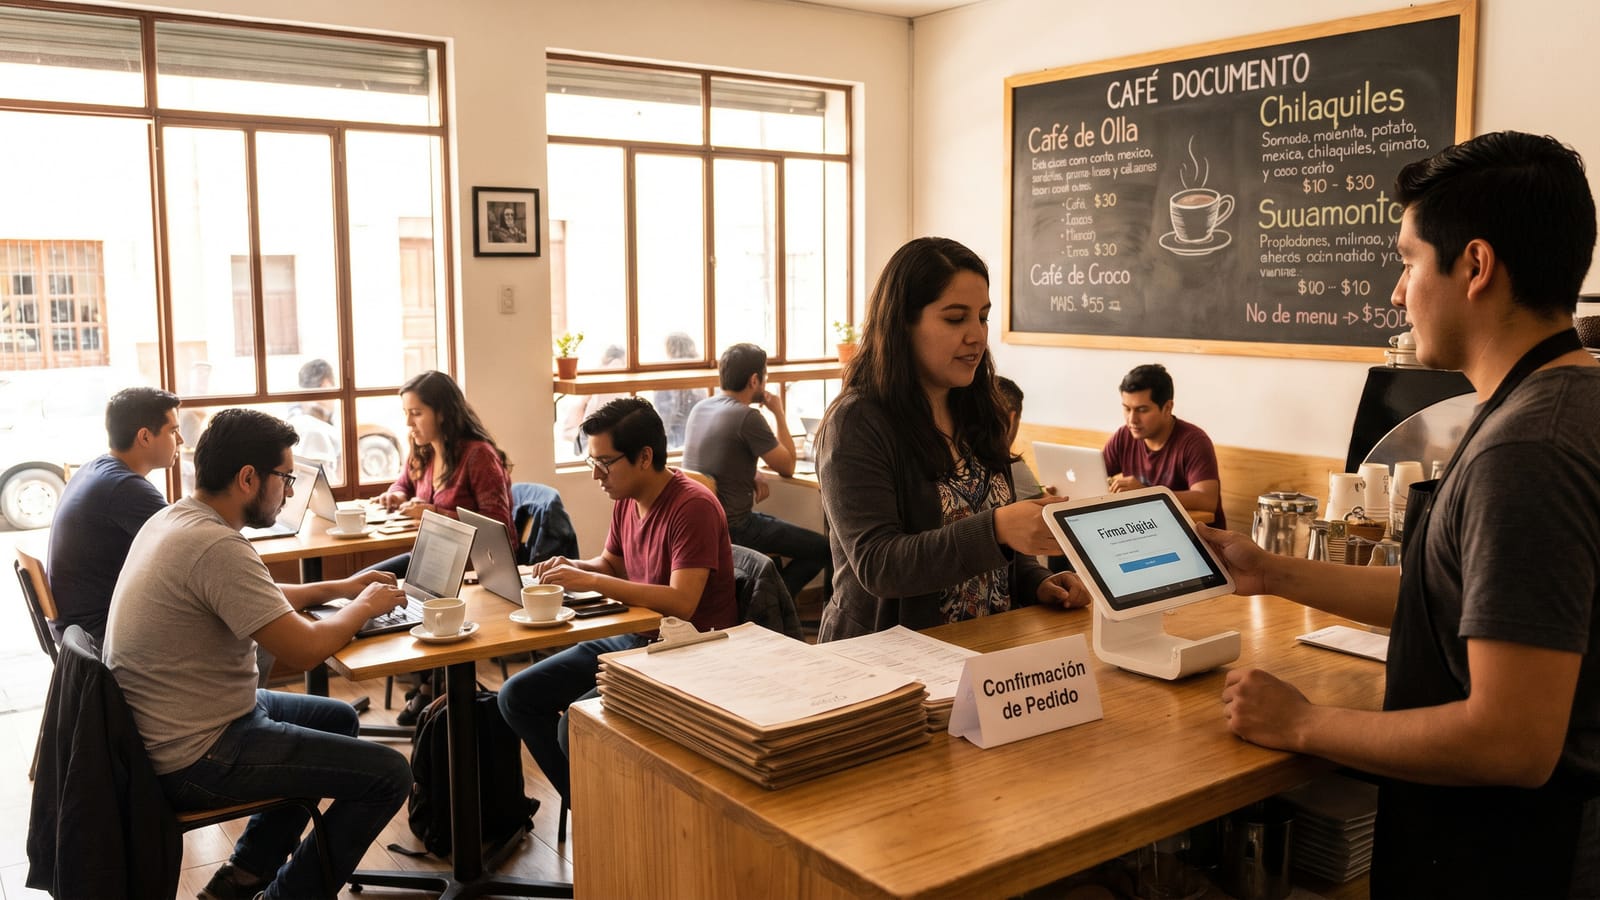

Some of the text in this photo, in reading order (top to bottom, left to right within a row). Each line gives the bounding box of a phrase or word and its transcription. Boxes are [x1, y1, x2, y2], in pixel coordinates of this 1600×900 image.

[1107, 53, 1310, 109] CAFÉ DOCUMENTO
[1260, 80, 1405, 129] Chilaquiles
[1028, 116, 1139, 153] Café de Olla
[1372, 118, 1417, 142] potato,
[1117, 147, 1154, 161] mexico,
[1262, 148, 1304, 162] mexica,
[1307, 140, 1376, 162] chilaquiles,
[1112, 167, 1119, 181] y
[1262, 168, 1270, 184] y
[1303, 178, 1328, 194] $10
[1346, 175, 1375, 192] $30
[1094, 193, 1117, 209] $30
[1094, 242, 1118, 257] $30
[1030, 263, 1130, 286] Café de Croco
[1341, 278, 1371, 296] $10
[1081, 292, 1105, 313] $55
[1246, 302, 1267, 323] No
[1271, 303, 1291, 323] de
[1295, 311, 1338, 326] menu
[1097, 526, 1127, 540] Firma
[1125, 518, 1158, 535] Digital
[983, 660, 1086, 697] Confirmación
[1003, 688, 1079, 719] de Pedido
